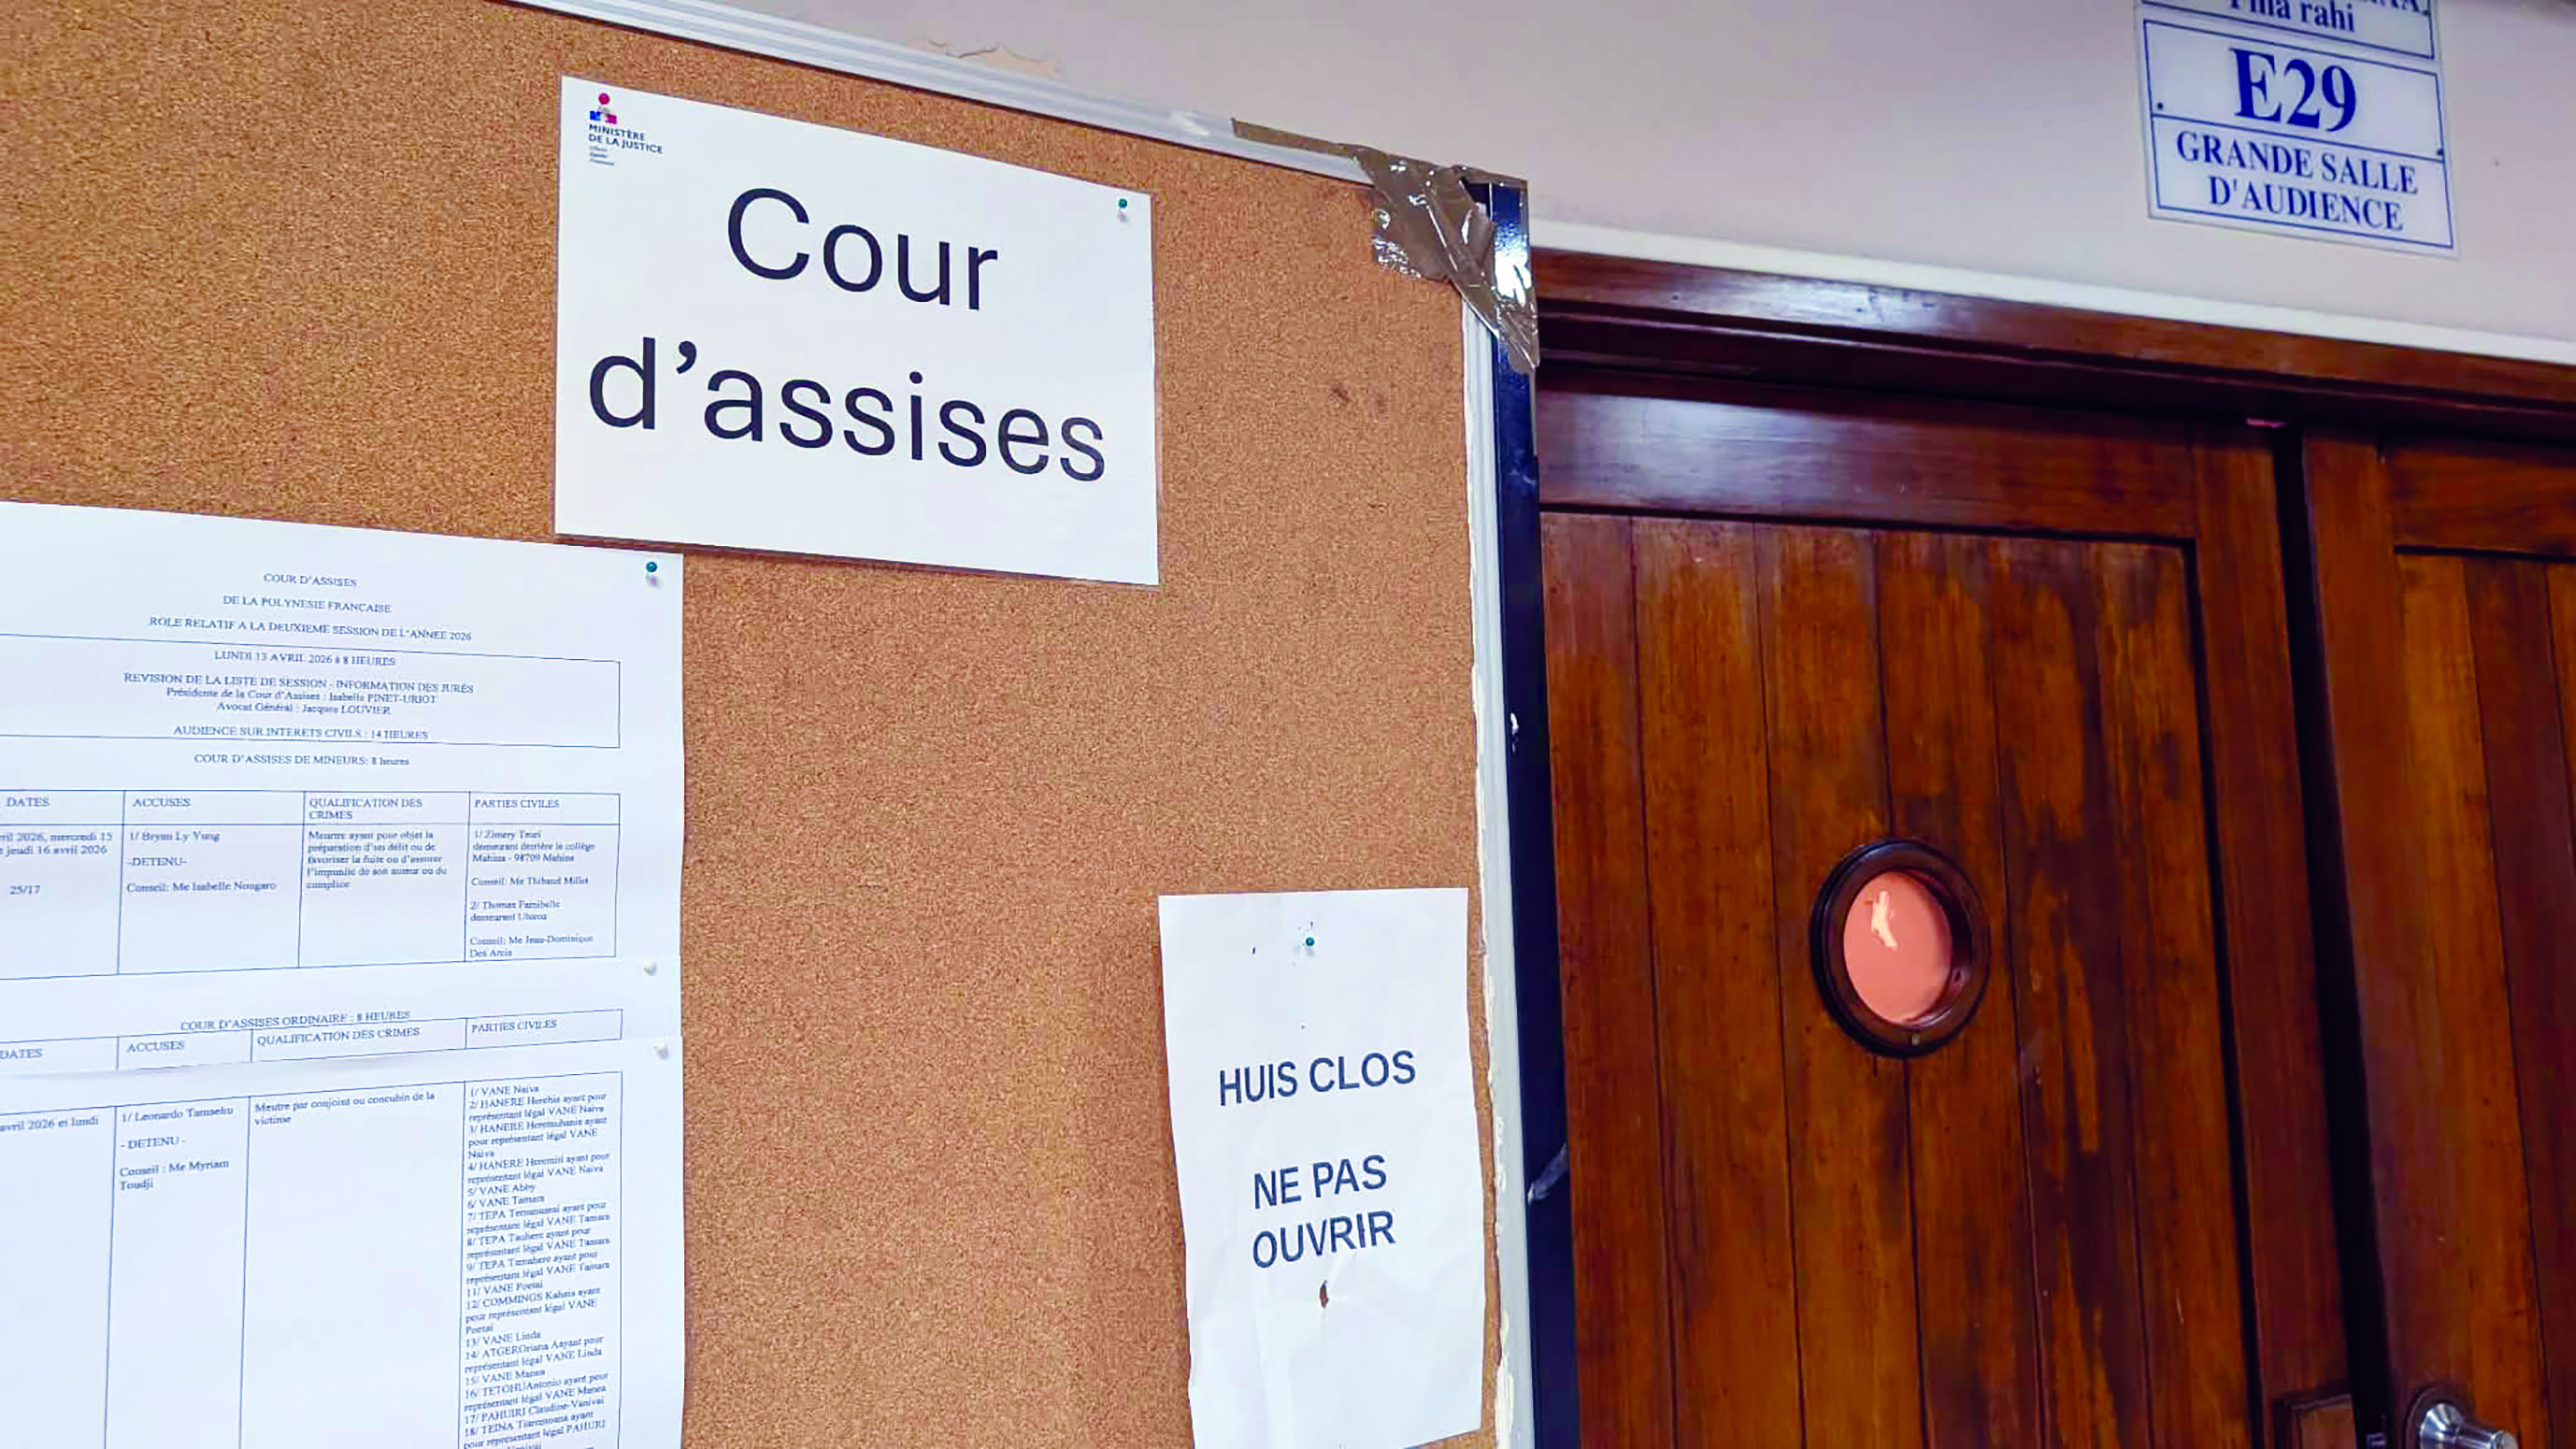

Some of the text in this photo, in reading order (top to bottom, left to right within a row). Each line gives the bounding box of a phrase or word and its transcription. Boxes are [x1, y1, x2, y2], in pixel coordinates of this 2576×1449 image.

[2300, 0, 2354, 32] rahi
[2228, 48, 2356, 132] E29
[589, 123, 645, 141] MINISTÈRE
[588, 134, 664, 154] DE LA JUSTICE
[2177, 130, 2419, 194] GRANDE SALLE
[2208, 176, 2404, 231] D'AUDIENCE
[727, 187, 998, 310] Cour
[589, 337, 1106, 482] d'assises
[264, 573, 357, 587] COUR D'ASSISES
[222, 595, 392, 612] DE LA POLYNESIE FRANCAISE
[150, 616, 182, 627] ROLE
[185, 618, 236, 629] RELATIF
[250, 621, 265, 631] LA
[268, 622, 330, 634] DEUXIEME
[333, 624, 379, 637] SESSION
[381, 627, 397, 637] DE
[449, 630, 472, 640] 2026
[214, 651, 252, 661] LUNDI
[269, 653, 303, 663] AVRIL
[308, 653, 333, 664] 2026
[351, 655, 396, 666] HEURES
[185, 674, 202, 684] DE
[206, 675, 222, 685] LA
[224, 676, 258, 686] LISTE
[260, 677, 277, 687] DE
[279, 678, 327, 689] SESSION
[336, 679, 415, 692] INFORMATION
[417, 681, 439, 692] DES
[247, 690, 273, 699] Cour
[274, 690, 321, 700] d'Assises
[217, 701, 252, 711] Avocat
[254, 702, 293, 712] Général
[302, 703, 339, 716] Jacques
[174, 725, 237, 736] AUDIENCE
[239, 726, 265, 737] SUR
[323, 728, 363, 739] CIVILS
[383, 729, 428, 739] HEURES
[193, 754, 228, 763] COUR
[232, 754, 292, 764] D'ASSISES
[294, 755, 310, 764] DE
[379, 756, 409, 766] heures
[6, 797, 50, 808] DATES
[133, 797, 191, 808] ACCUSES
[308, 797, 422, 809] QUALIFICATION DES
[474, 798, 560, 808] PARTIES CIVILES
[308, 810, 353, 820] CRIMES
[376, 832, 398, 840] pour
[400, 830, 422, 840] objet
[52, 845, 78, 854] avril
[80, 844, 107, 854] 2026
[172, 882, 190, 892] Me
[180, 1019, 215, 1030] COUR
[219, 1016, 280, 1028] D'ASSISES
[281, 1012, 348, 1026] ORDINAIRE
[365, 1010, 410, 1021] HEURES
[471, 1019, 557, 1034] PARTIES CIVILES
[256, 1027, 421, 1046] QUALIFICATION DES CRIMES
[126, 1040, 185, 1053] ACCUSES
[0, 1048, 43, 1060] DATES
[1219, 1050, 1416, 1107] HUIS CLOS
[480, 1085, 510, 1096] VANE
[293, 1100, 308, 1112] par
[310, 1096, 351, 1111] conjoint
[135, 1109, 183, 1122] Leonardo
[254, 1113, 292, 1126] victime
[27, 1119, 56, 1130] 2026
[127, 1136, 179, 1150] DETENU
[119, 1158, 229, 1177] Conseil Me Myriam
[1253, 1154, 1387, 1210] NE PAS
[479, 1184, 509, 1195] VANE
[479, 1197, 509, 1208] VANE
[1252, 1210, 1395, 1270] OUVRIR
[482, 1333, 512, 1345] VANE
